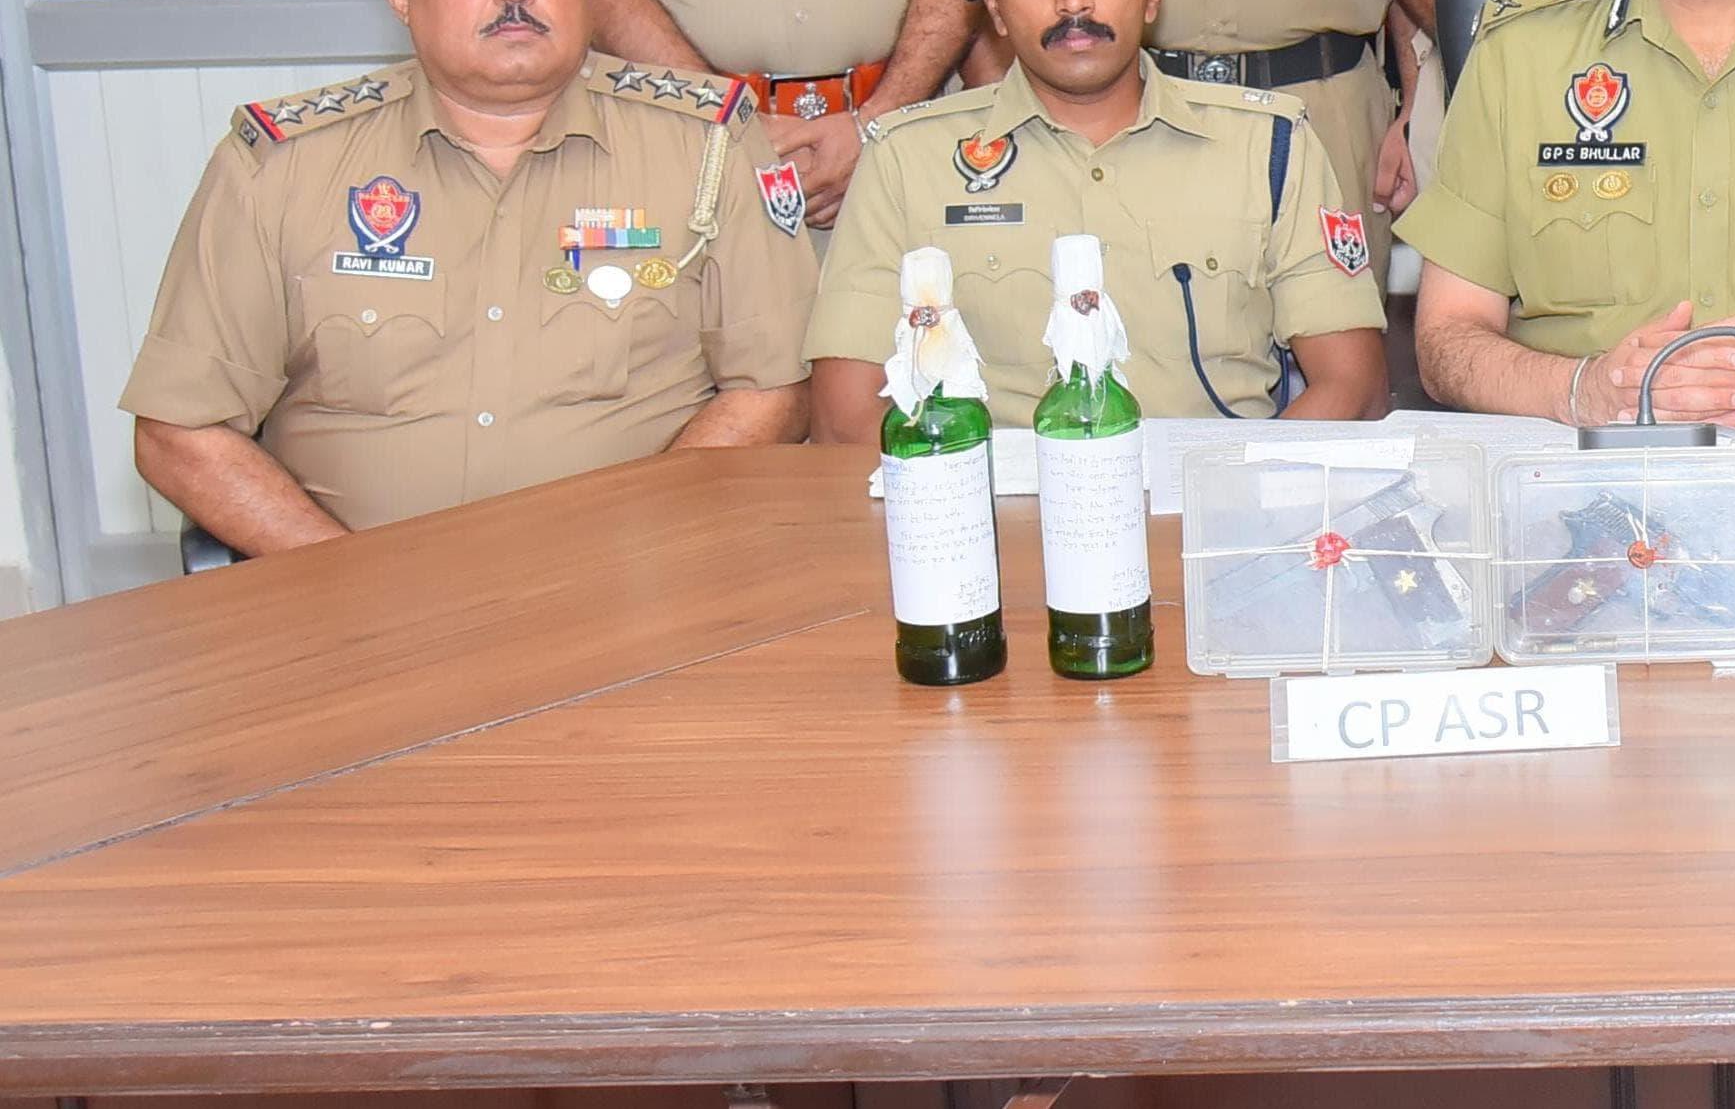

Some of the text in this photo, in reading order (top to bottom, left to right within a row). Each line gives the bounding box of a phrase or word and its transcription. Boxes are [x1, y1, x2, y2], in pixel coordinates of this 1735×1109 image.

[1542, 146, 1641, 160] G P S BHULLAR
[342, 256, 425, 274] RAVI KUMAR
[1338, 689, 1550, 749] CP ASR
